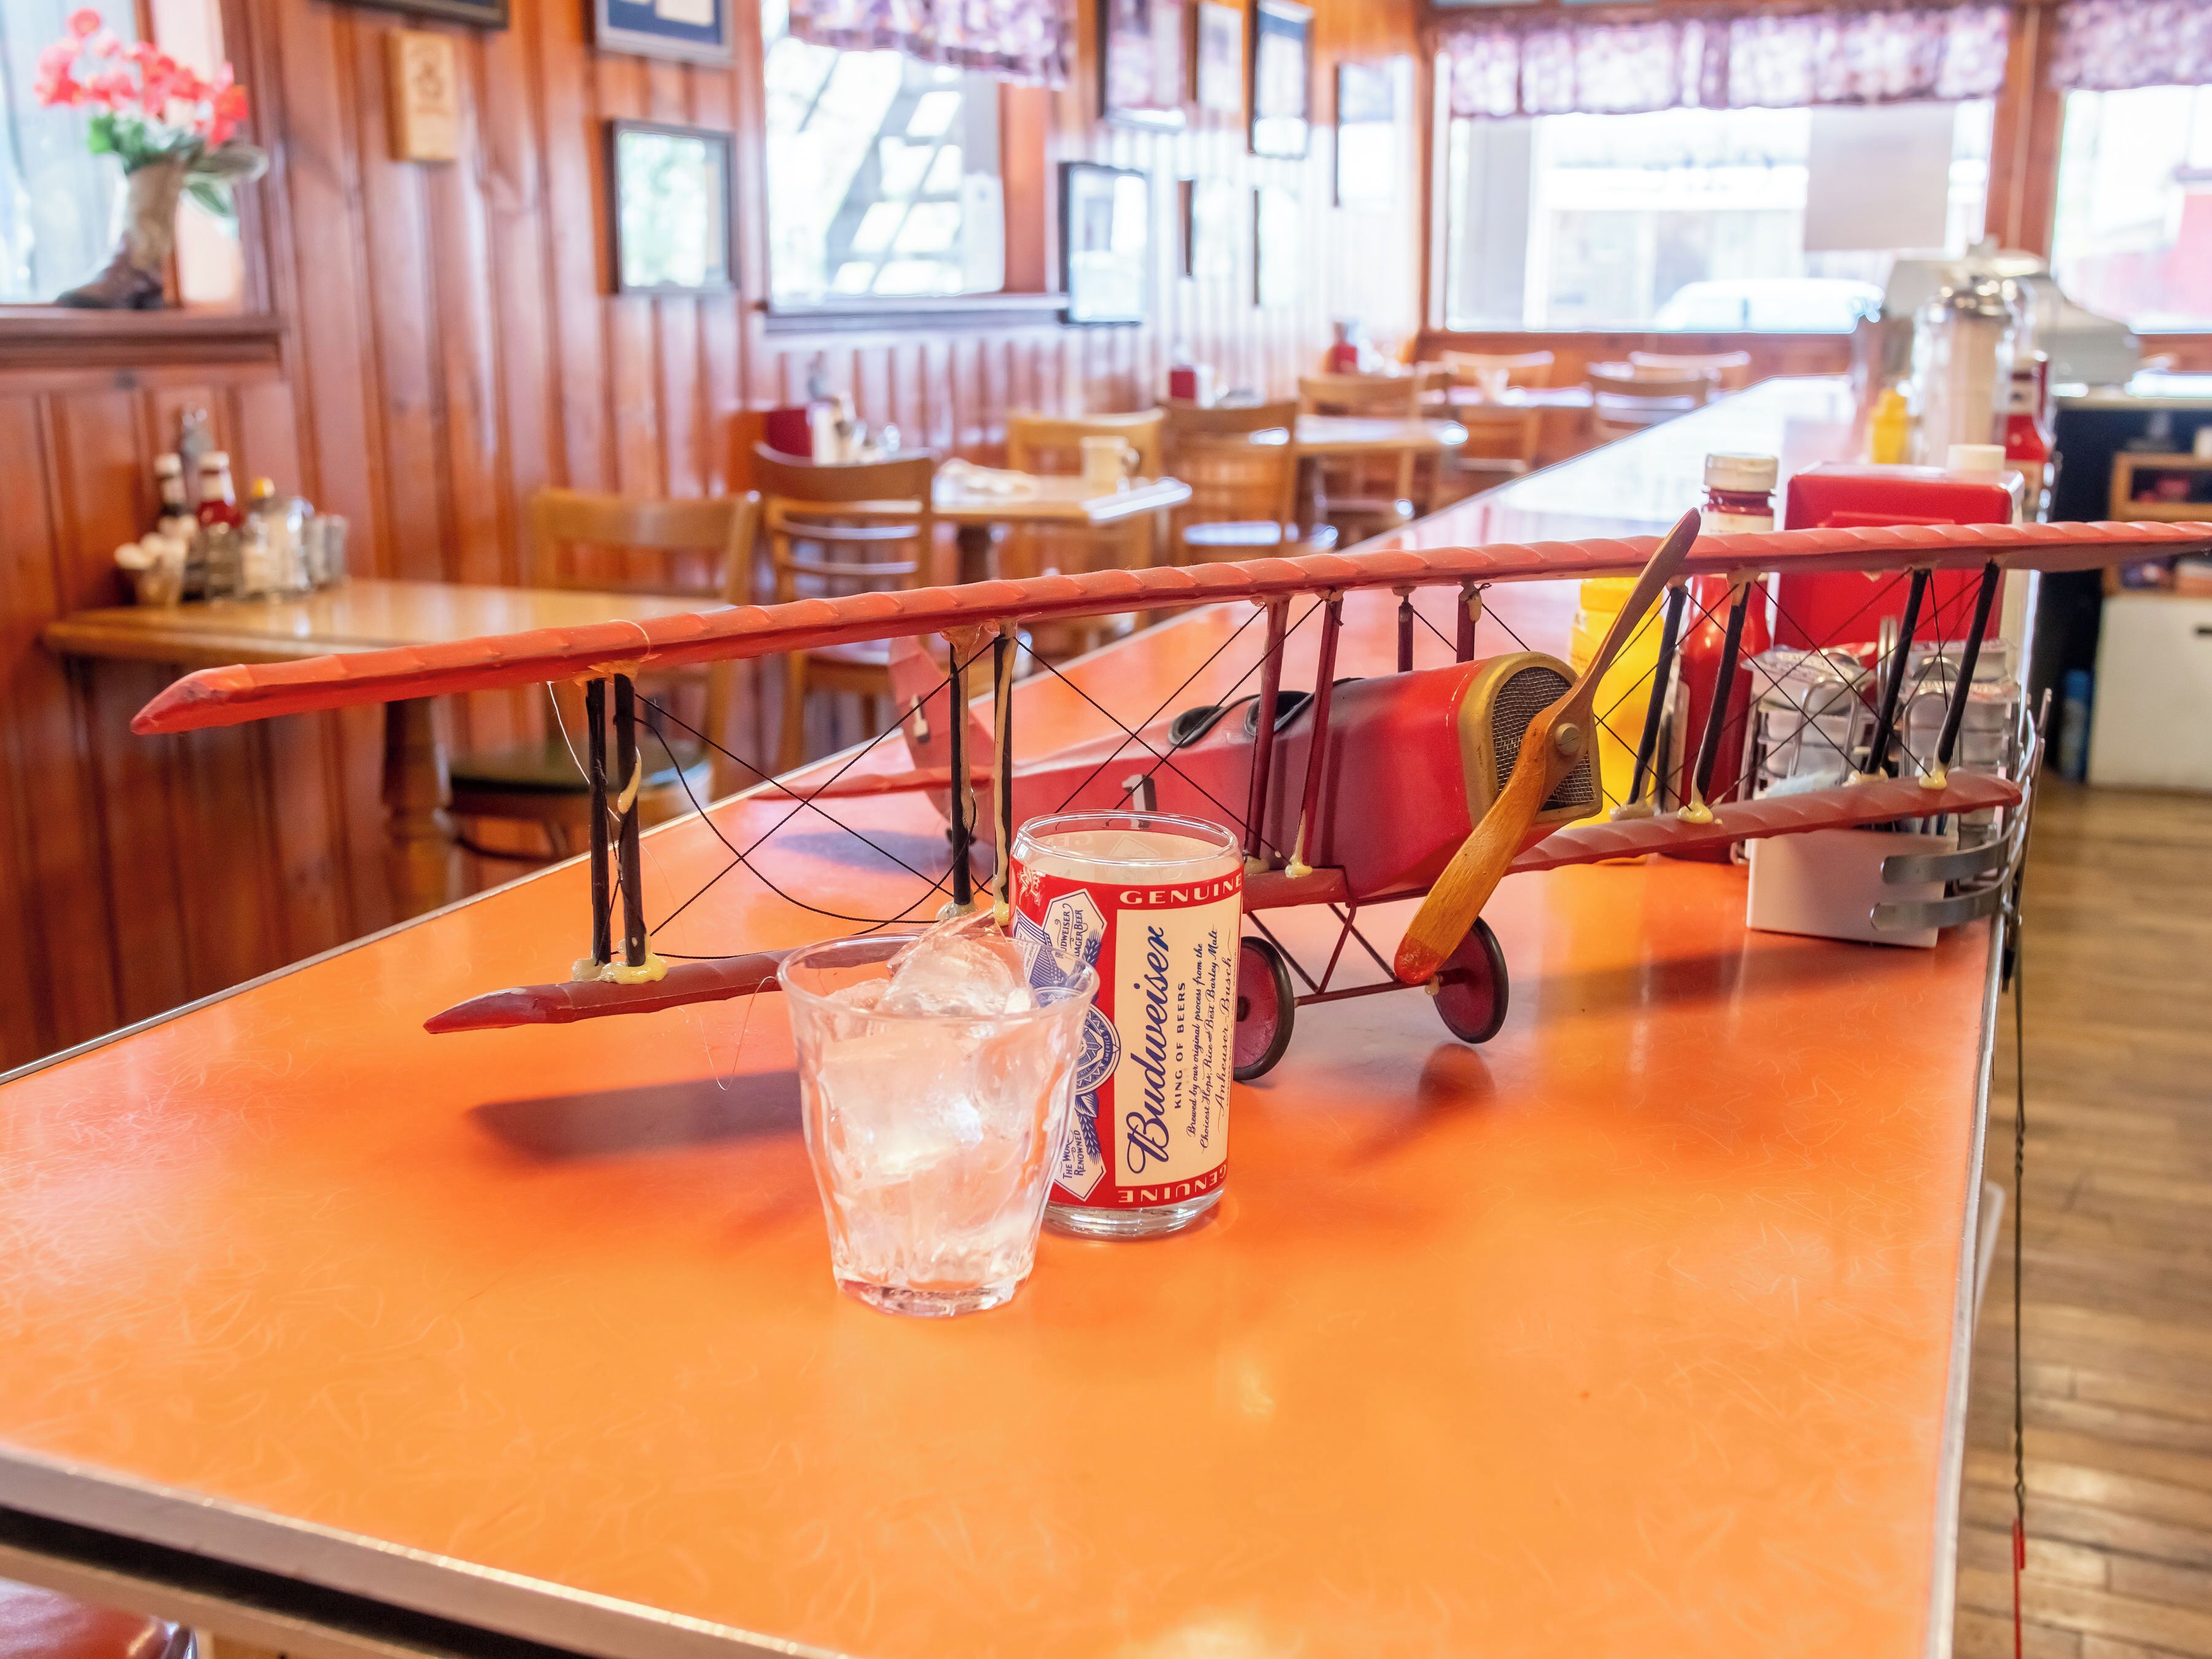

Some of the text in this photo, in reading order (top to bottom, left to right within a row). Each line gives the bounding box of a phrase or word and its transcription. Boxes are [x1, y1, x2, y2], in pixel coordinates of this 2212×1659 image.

[1120, 873, 1242, 904] GENUINE
[1061, 911, 1070, 952] UDWEISER
[1074, 909, 1084, 930] BEER
[1193, 943, 1203, 958] the
[1208, 924, 1218, 960] Malt
[1192, 960, 1205, 986] from
[1206, 962, 1220, 1002] Barley
[1194, 988, 1204, 1021] process
[1204, 1003, 1215, 1033] Best
[1174, 982, 1185, 1109] KING OF BEERS
[1191, 1024, 1204, 1062] original
[1215, 927, 1232, 1134] Anheuser-Busch
[1126, 925, 1169, 1174] Budweiser
[1202, 1044, 1213, 1080] Rice
[1189, 1085, 1201, 1097] by
[1186, 1099, 1197, 1137] Brewed
[1200, 1106, 1210, 1155] Choicest
[1062, 1164, 1073, 1179] THE
[1073, 1130, 1086, 1176] RENOWNED
[1118, 1164, 1227, 1202] GENUINE
